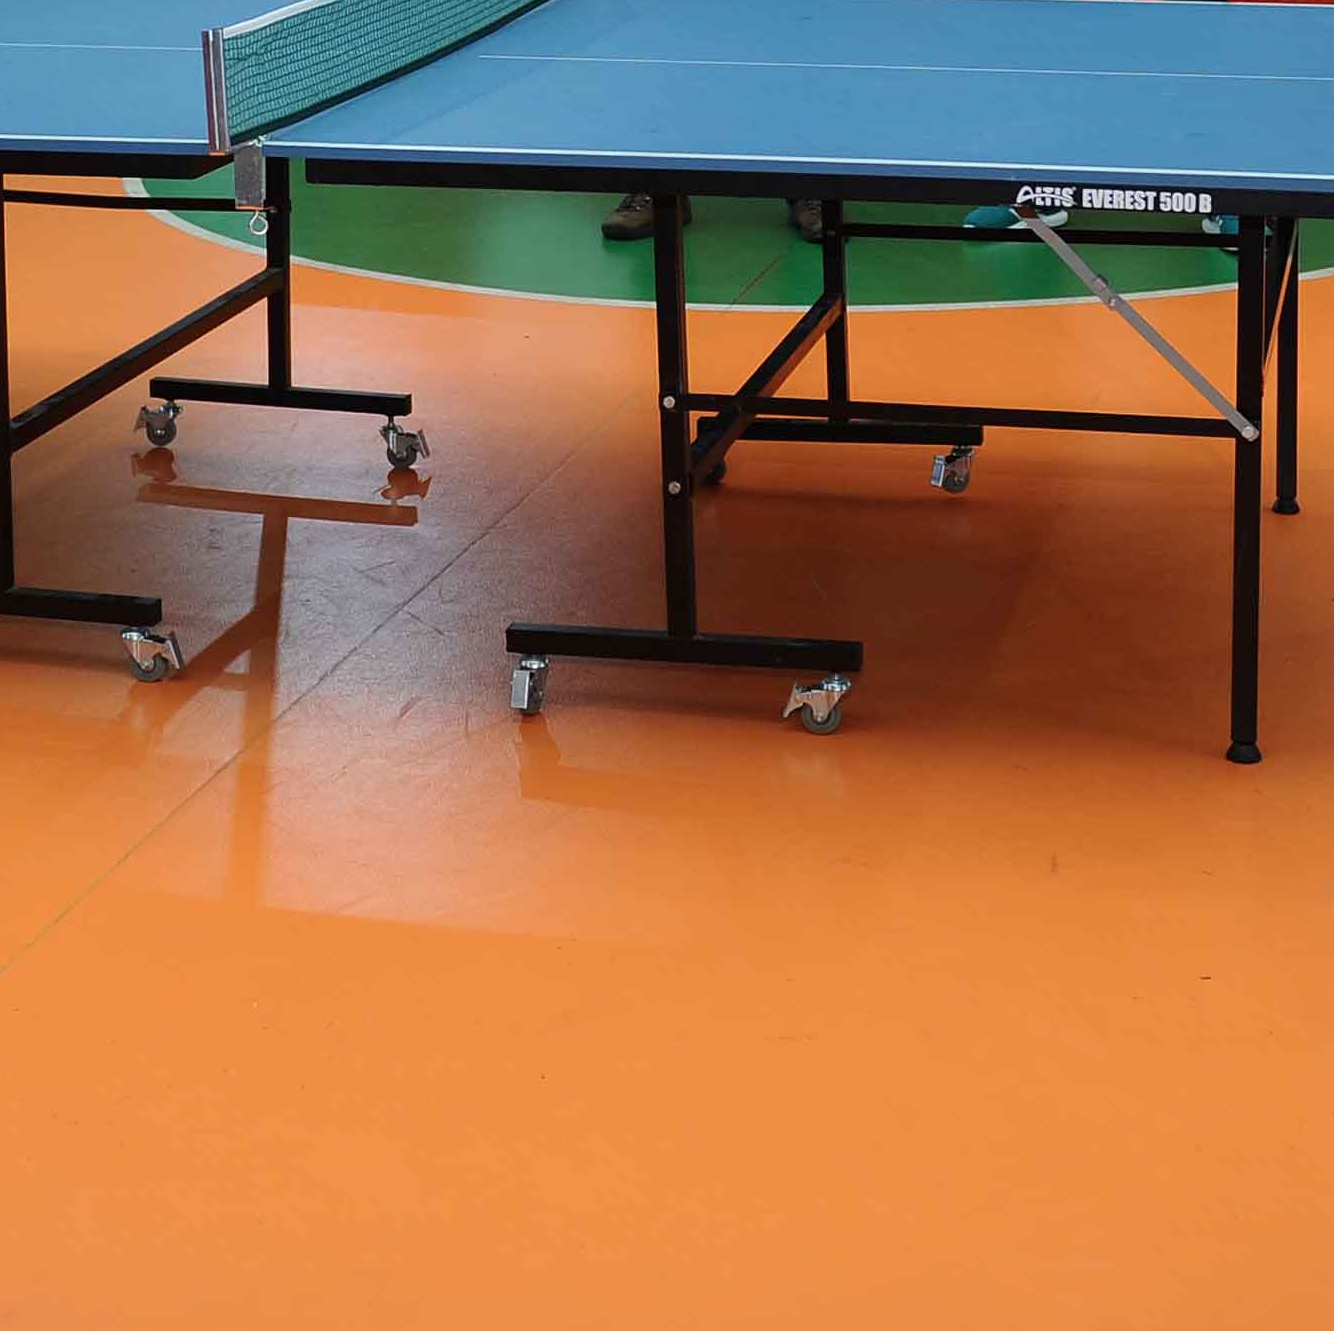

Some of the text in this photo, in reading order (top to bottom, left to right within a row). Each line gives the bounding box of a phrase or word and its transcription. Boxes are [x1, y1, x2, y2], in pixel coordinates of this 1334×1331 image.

[1082, 188, 1156, 211] EVEREST
[1159, 192, 1197, 213] 500
[1198, 193, 1212, 213] B
